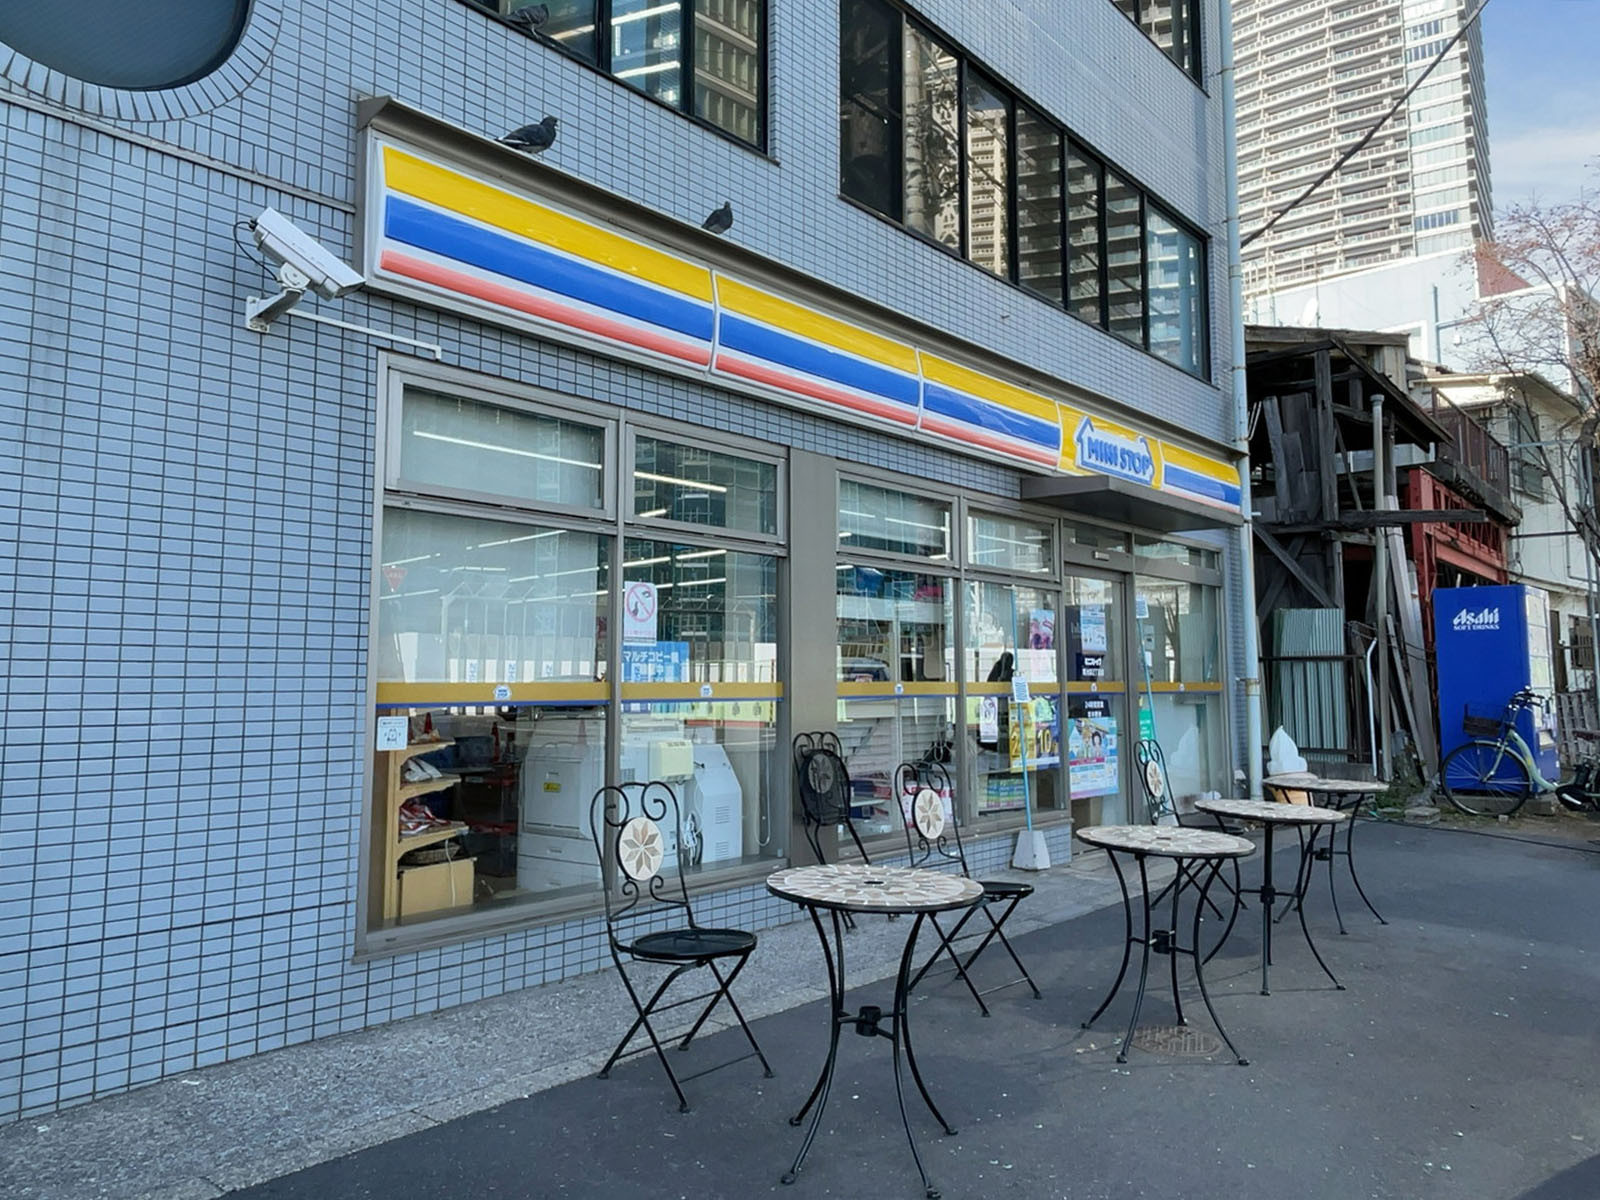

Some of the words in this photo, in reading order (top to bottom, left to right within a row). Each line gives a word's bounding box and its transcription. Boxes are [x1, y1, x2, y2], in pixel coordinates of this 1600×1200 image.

[1087, 436, 1118, 466] MINI
[1119, 447, 1151, 475] STOP
[1453, 607, 1500, 625] Asahi
